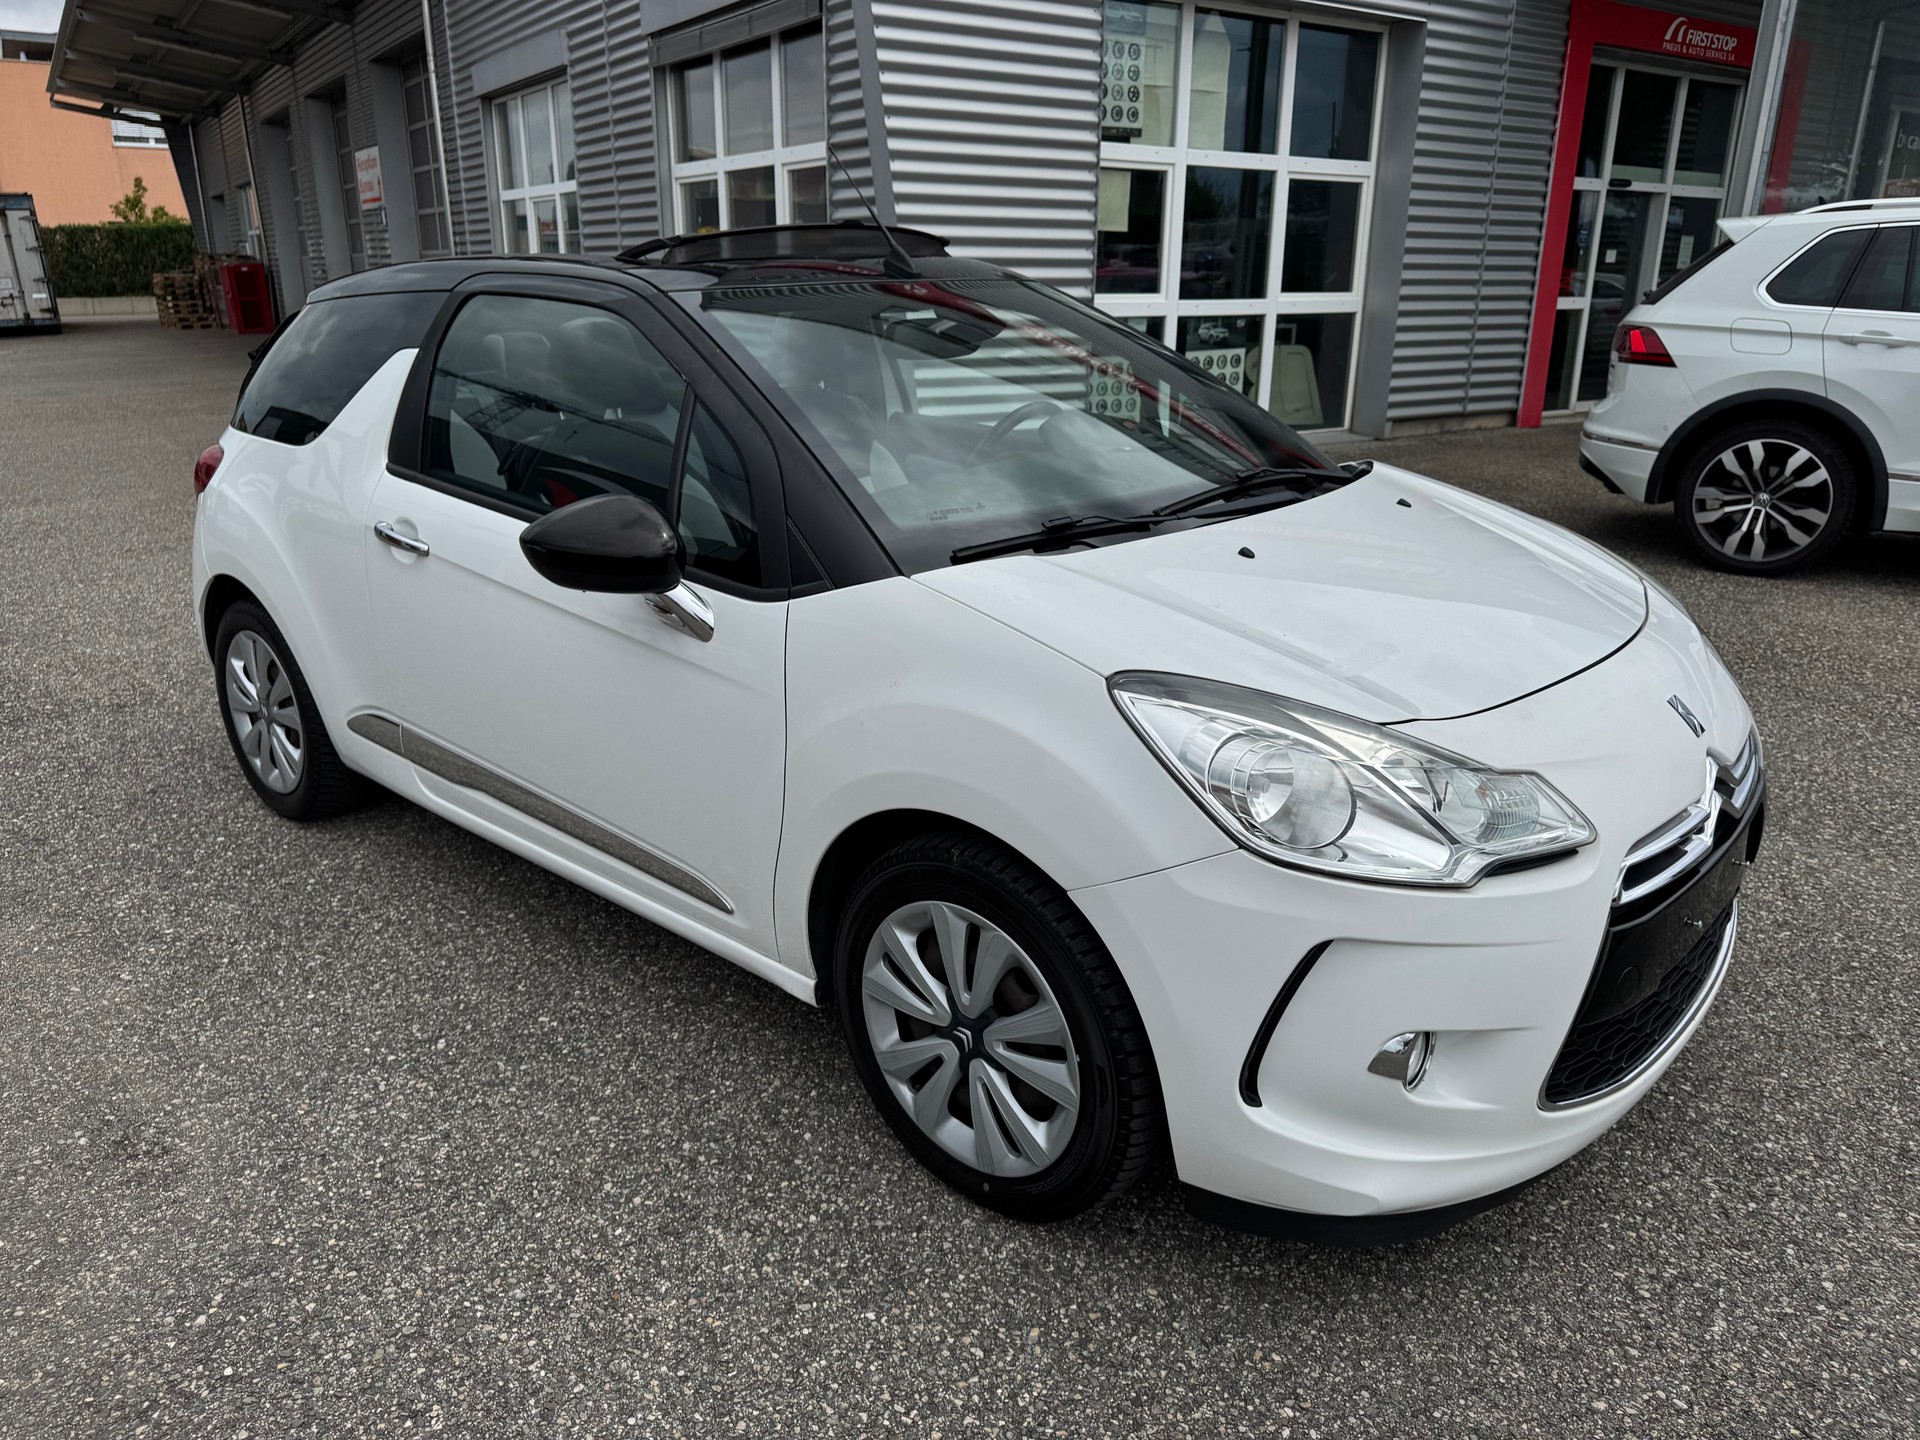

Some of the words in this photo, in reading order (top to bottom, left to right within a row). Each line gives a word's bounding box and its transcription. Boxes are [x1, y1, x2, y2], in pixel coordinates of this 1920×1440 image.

[1663, 41, 1681, 52] PNEUS
[1682, 45, 1687, 53] &
[1689, 46, 1704, 56] AUTO
[1705, 49, 1727, 60] SERVICE
[1728, 53, 1735, 62] SA
